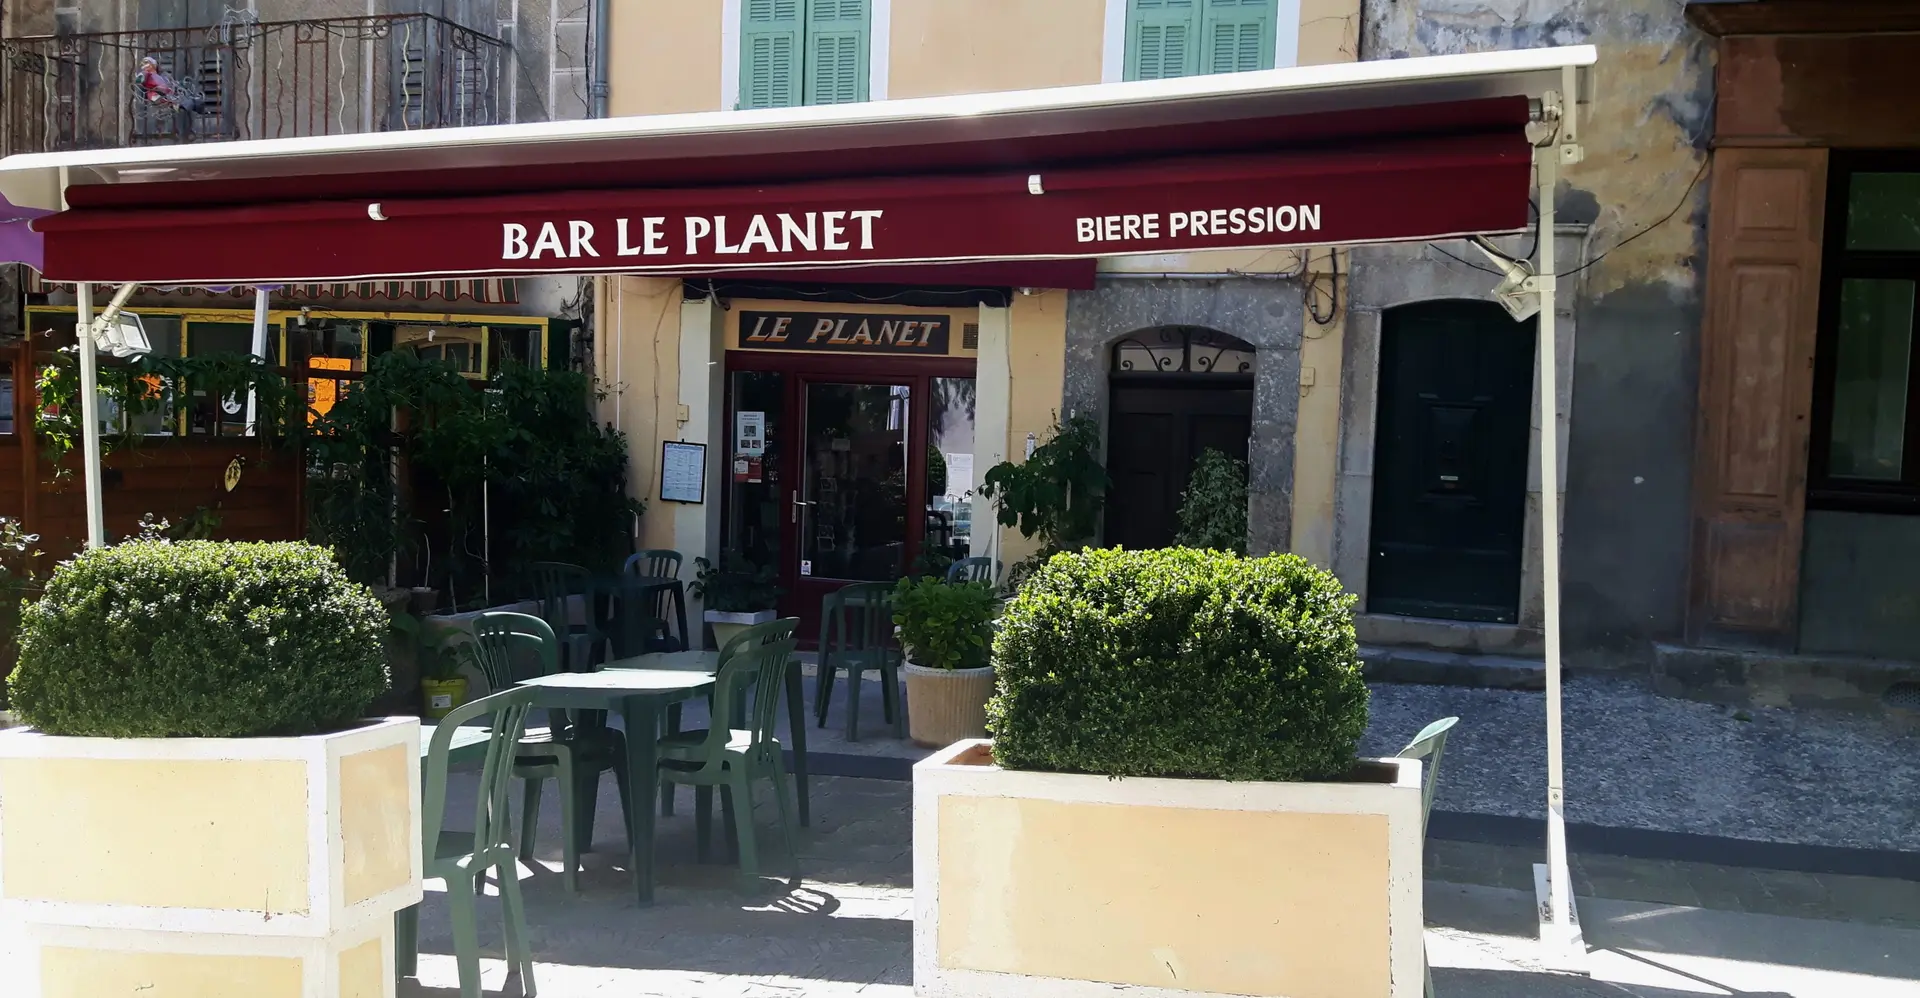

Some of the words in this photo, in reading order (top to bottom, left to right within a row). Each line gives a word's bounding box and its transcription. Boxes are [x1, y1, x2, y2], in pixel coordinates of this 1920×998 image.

[502, 220, 600, 259] BAR
[616, 217, 669, 256] LE
[684, 210, 883, 254] PLANET
[1076, 213, 1160, 242] BIERE
[1169, 204, 1321, 237] PRESSION
[746, 316, 792, 342] LE
[806, 318, 941, 347] PLANET
